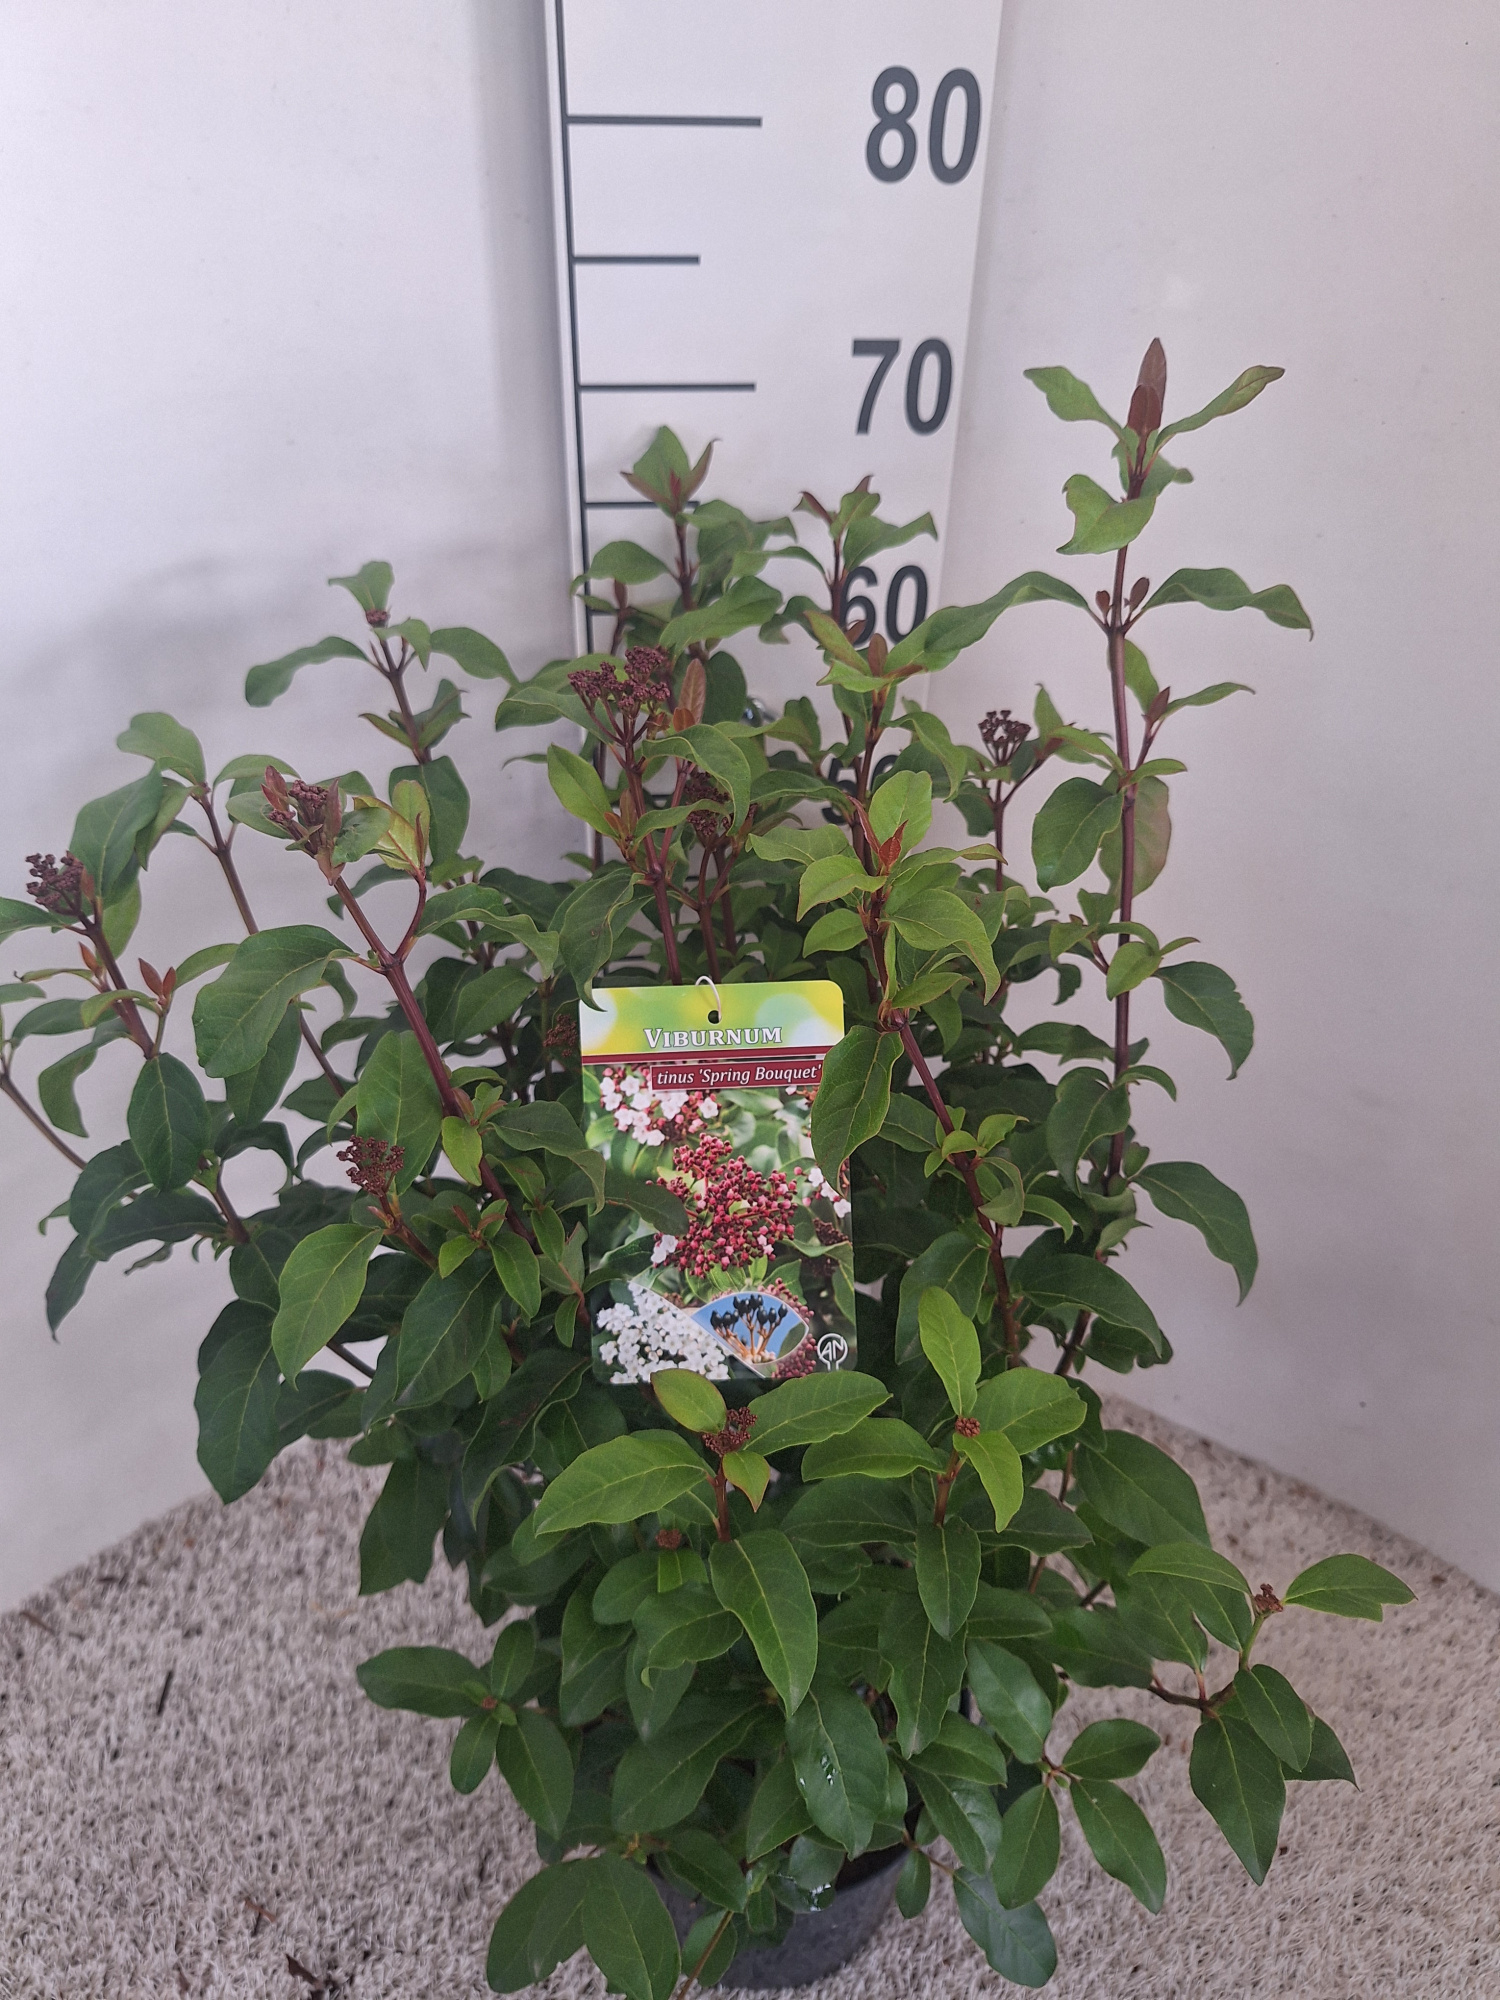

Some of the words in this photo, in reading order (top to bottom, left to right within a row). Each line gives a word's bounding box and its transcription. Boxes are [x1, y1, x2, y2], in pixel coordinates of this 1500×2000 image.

[866, 65, 982, 184] 80
[852, 337, 953, 435] 70
[841, 565, 929, 647] 60
[643, 1027, 783, 1049] VIBURNUM
[657, 1070, 695, 1085] tinus
[699, 1068, 751, 1086] 'Spring
[755, 1064, 823, 1084] Bouquet'
